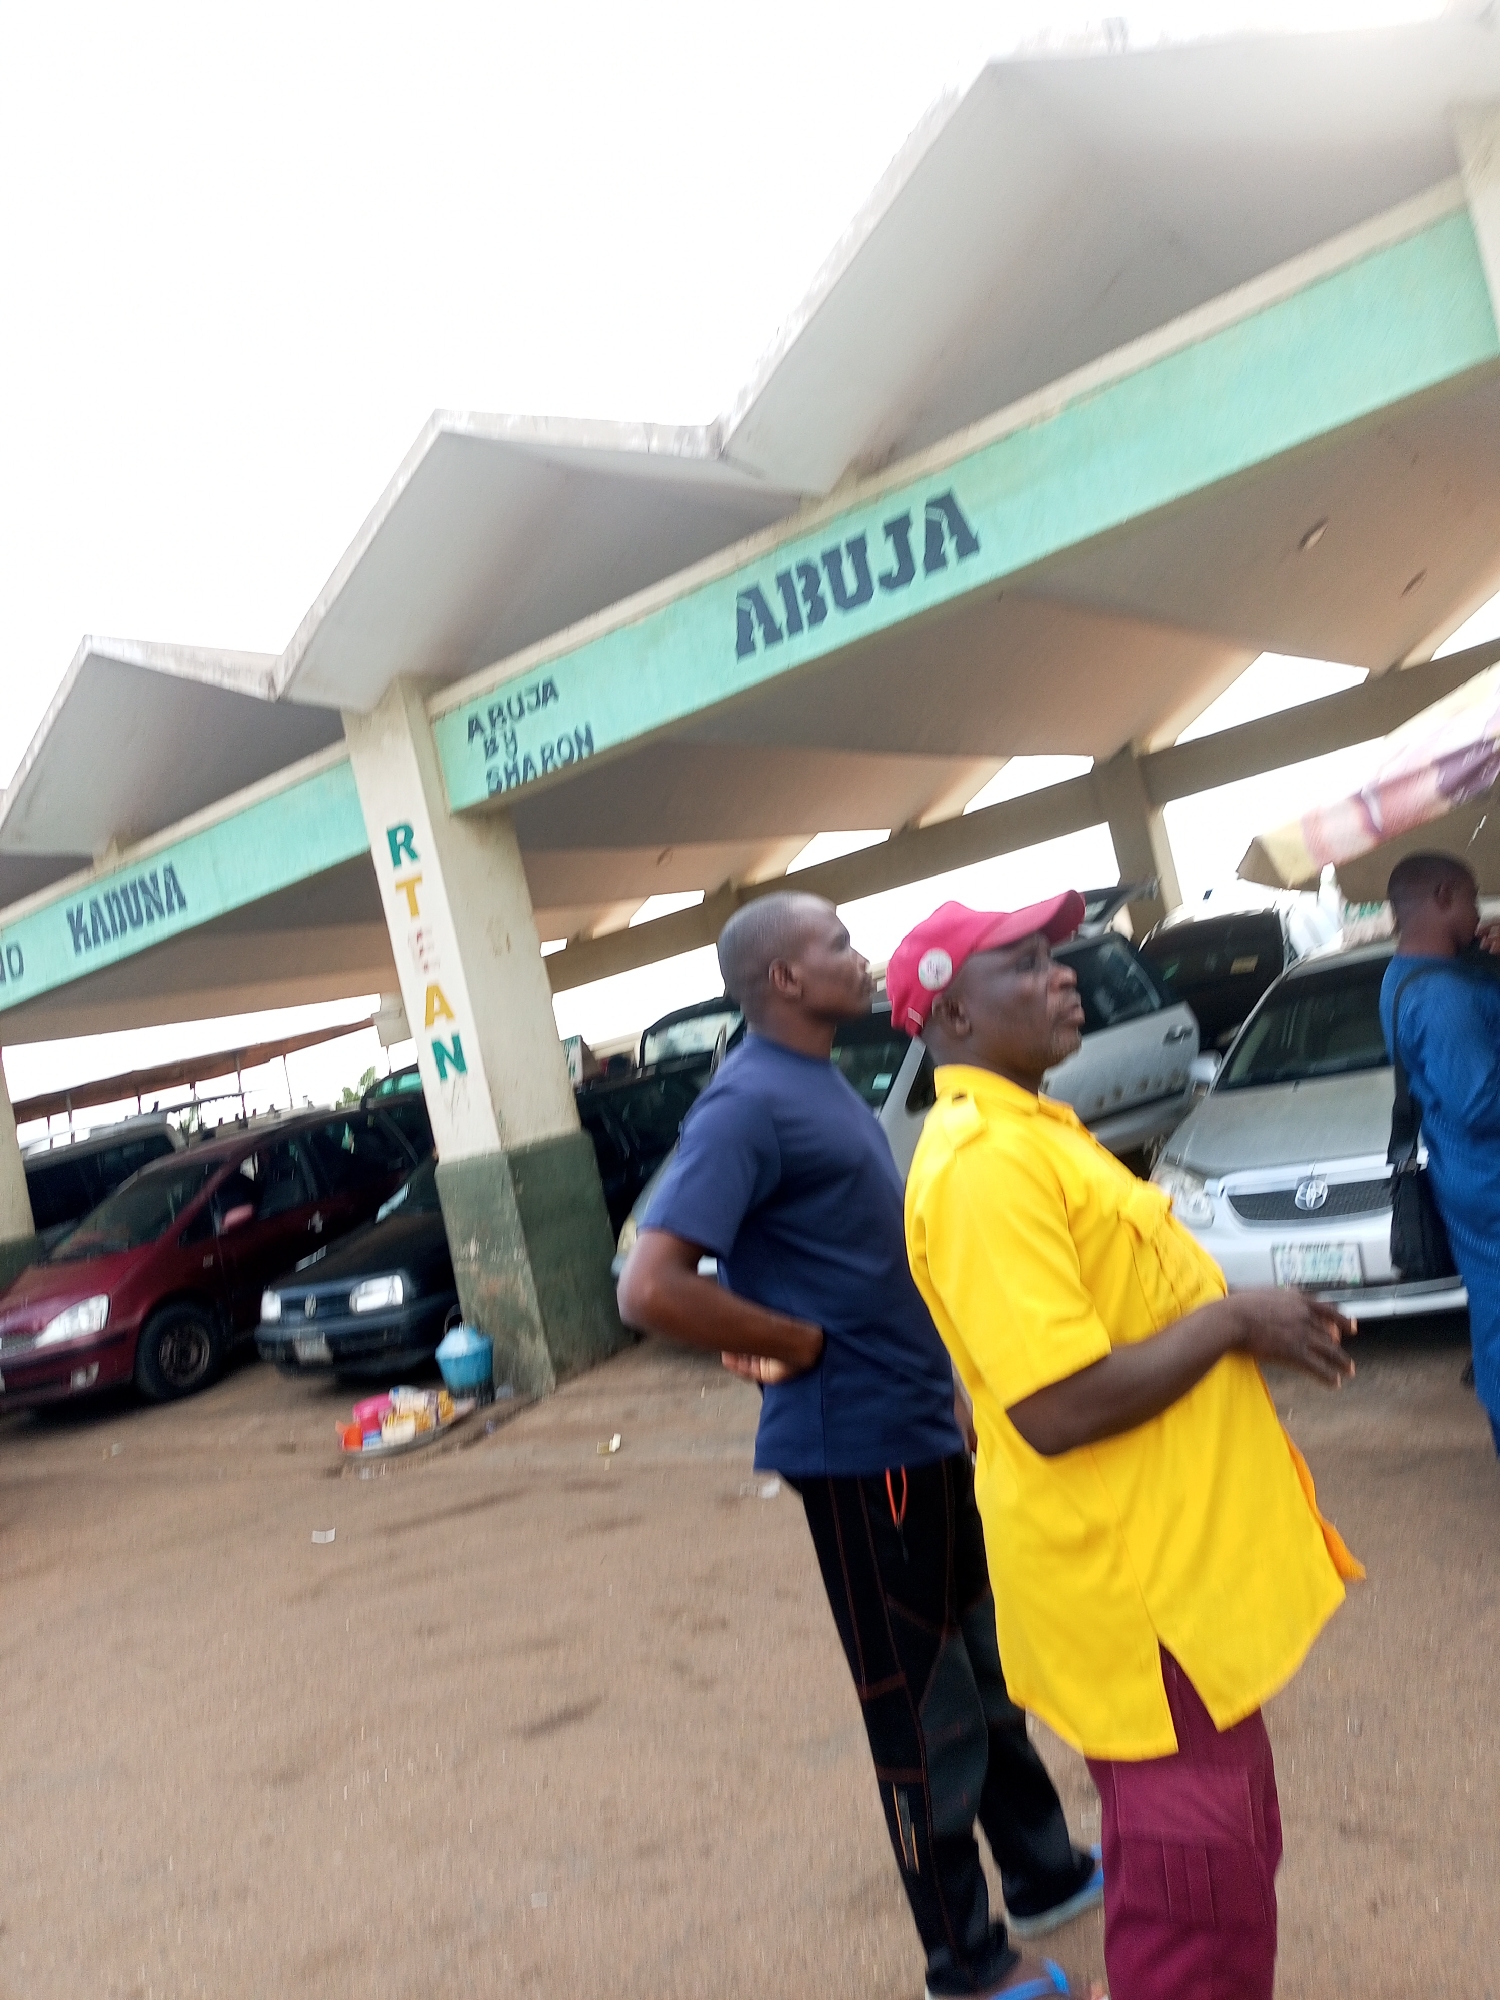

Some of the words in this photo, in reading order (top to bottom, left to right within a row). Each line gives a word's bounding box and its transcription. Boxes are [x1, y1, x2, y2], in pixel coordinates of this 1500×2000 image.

[736, 488, 979, 661] ABUJA
[468, 676, 558, 742] ABUJA
[487, 722, 594, 796] SHARON
[67, 861, 187, 954] KADUNA
